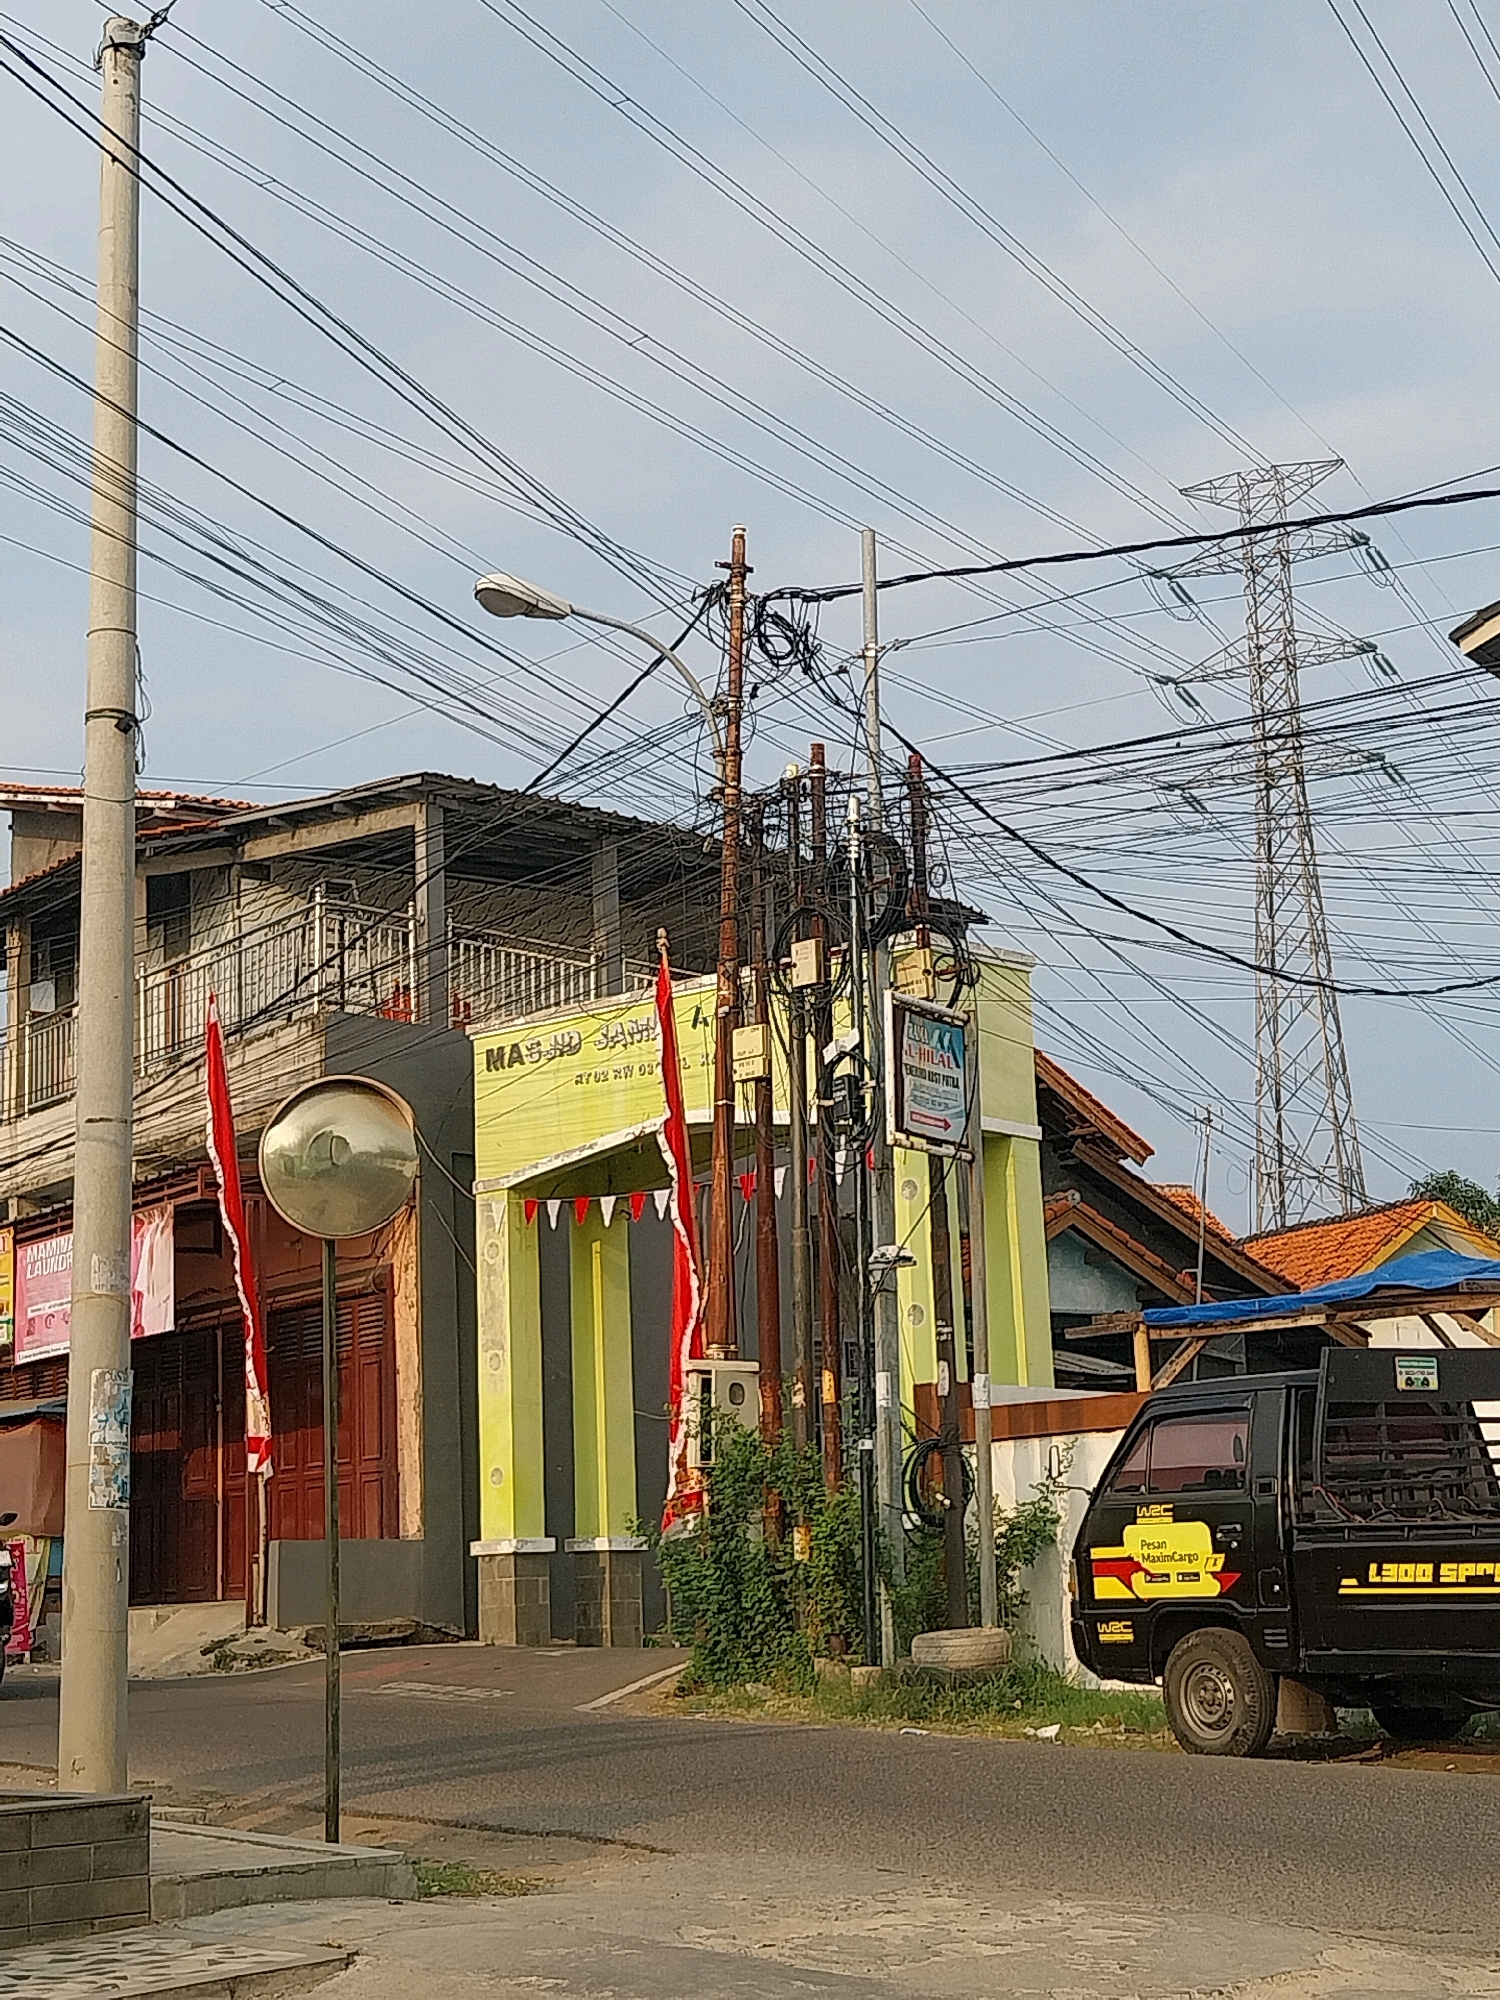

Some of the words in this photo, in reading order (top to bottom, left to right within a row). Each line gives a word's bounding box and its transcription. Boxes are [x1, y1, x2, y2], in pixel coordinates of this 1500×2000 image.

[26, 1250, 73, 1280] LAUNDR
[1140, 1539, 1167, 1551] Pesan
[1141, 1551, 1199, 1565] MaximCargo
